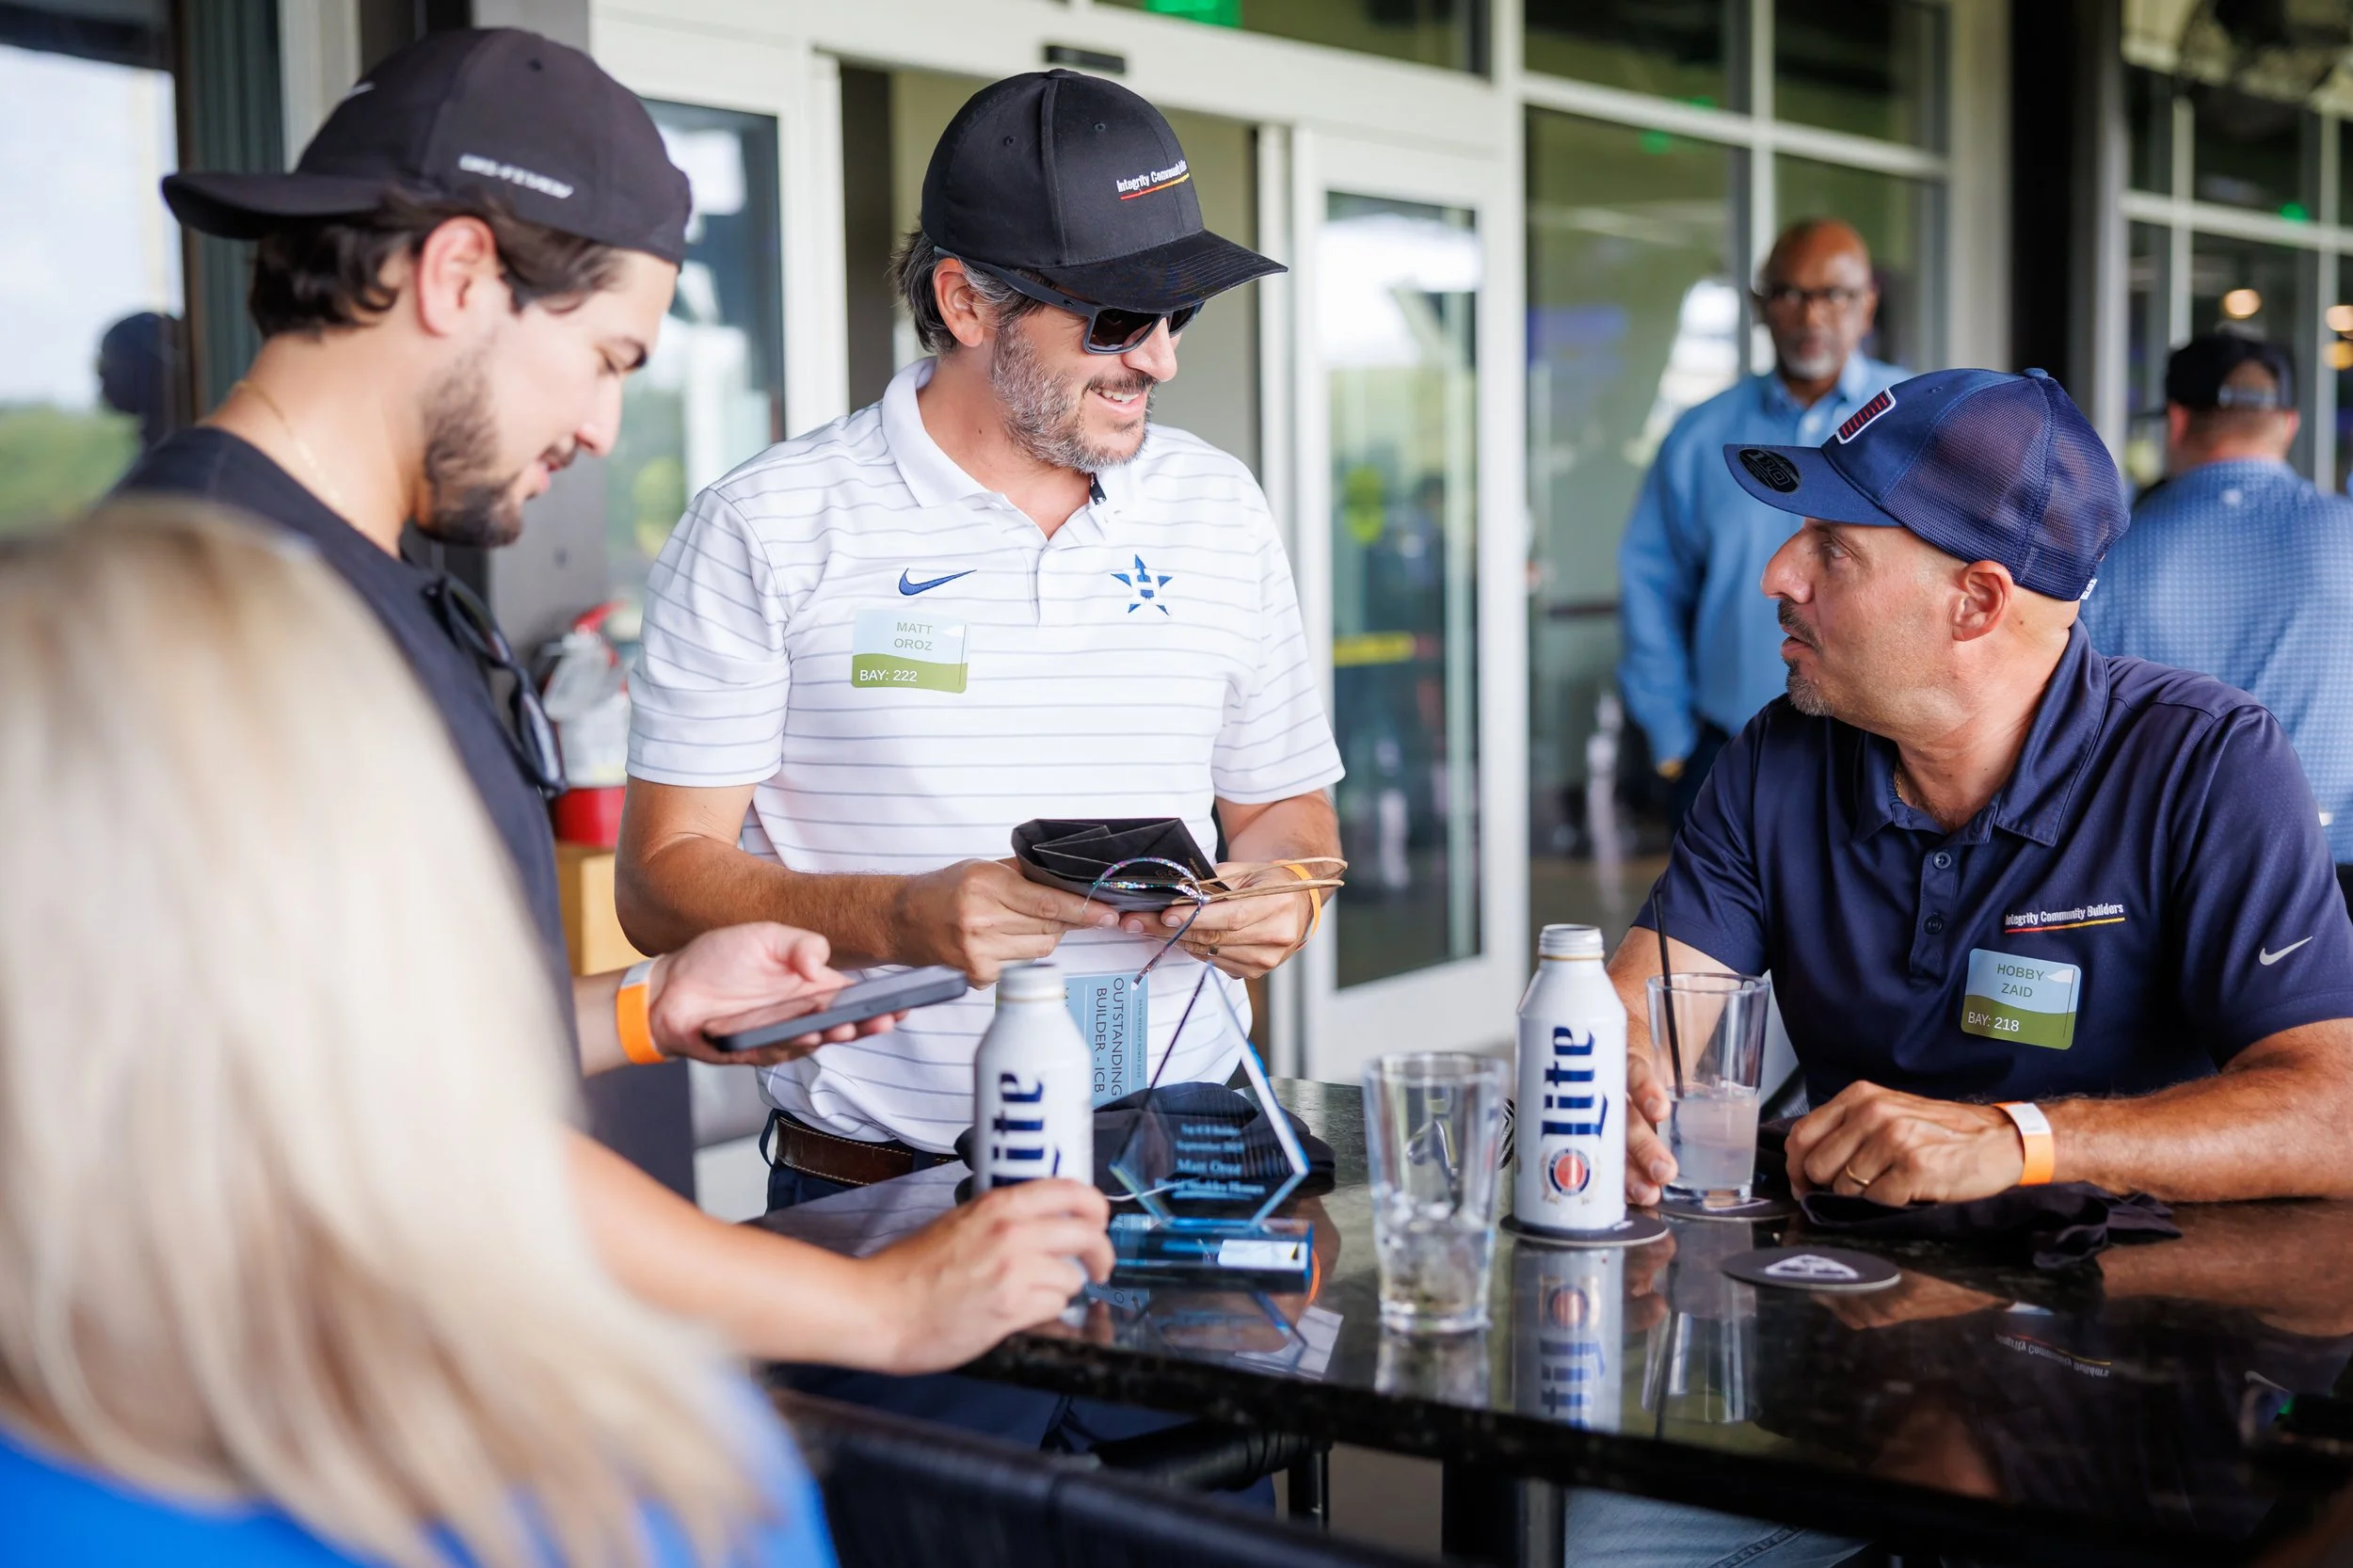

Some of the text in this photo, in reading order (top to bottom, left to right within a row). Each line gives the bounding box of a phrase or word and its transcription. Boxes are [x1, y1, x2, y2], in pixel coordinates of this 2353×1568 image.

[1116, 174, 1150, 193] Integrity
[896, 621, 933, 634] MATT
[894, 638, 933, 650] OROZ
[859, 669, 918, 681] BAY: 222
[2005, 903, 2124, 926] Integrity Community Builders
[1996, 963, 2044, 981] HOBBY
[2001, 983, 2033, 998] ZAID
[1095, 987, 1108, 1052] BUILDER
[1967, 1011, 2019, 1032] BAY: 218
[1111, 978, 1125, 1096] OUTSTANDING
[1094, 1066, 1106, 1093] ICB
[1541, 1026, 1608, 1141] Lite
